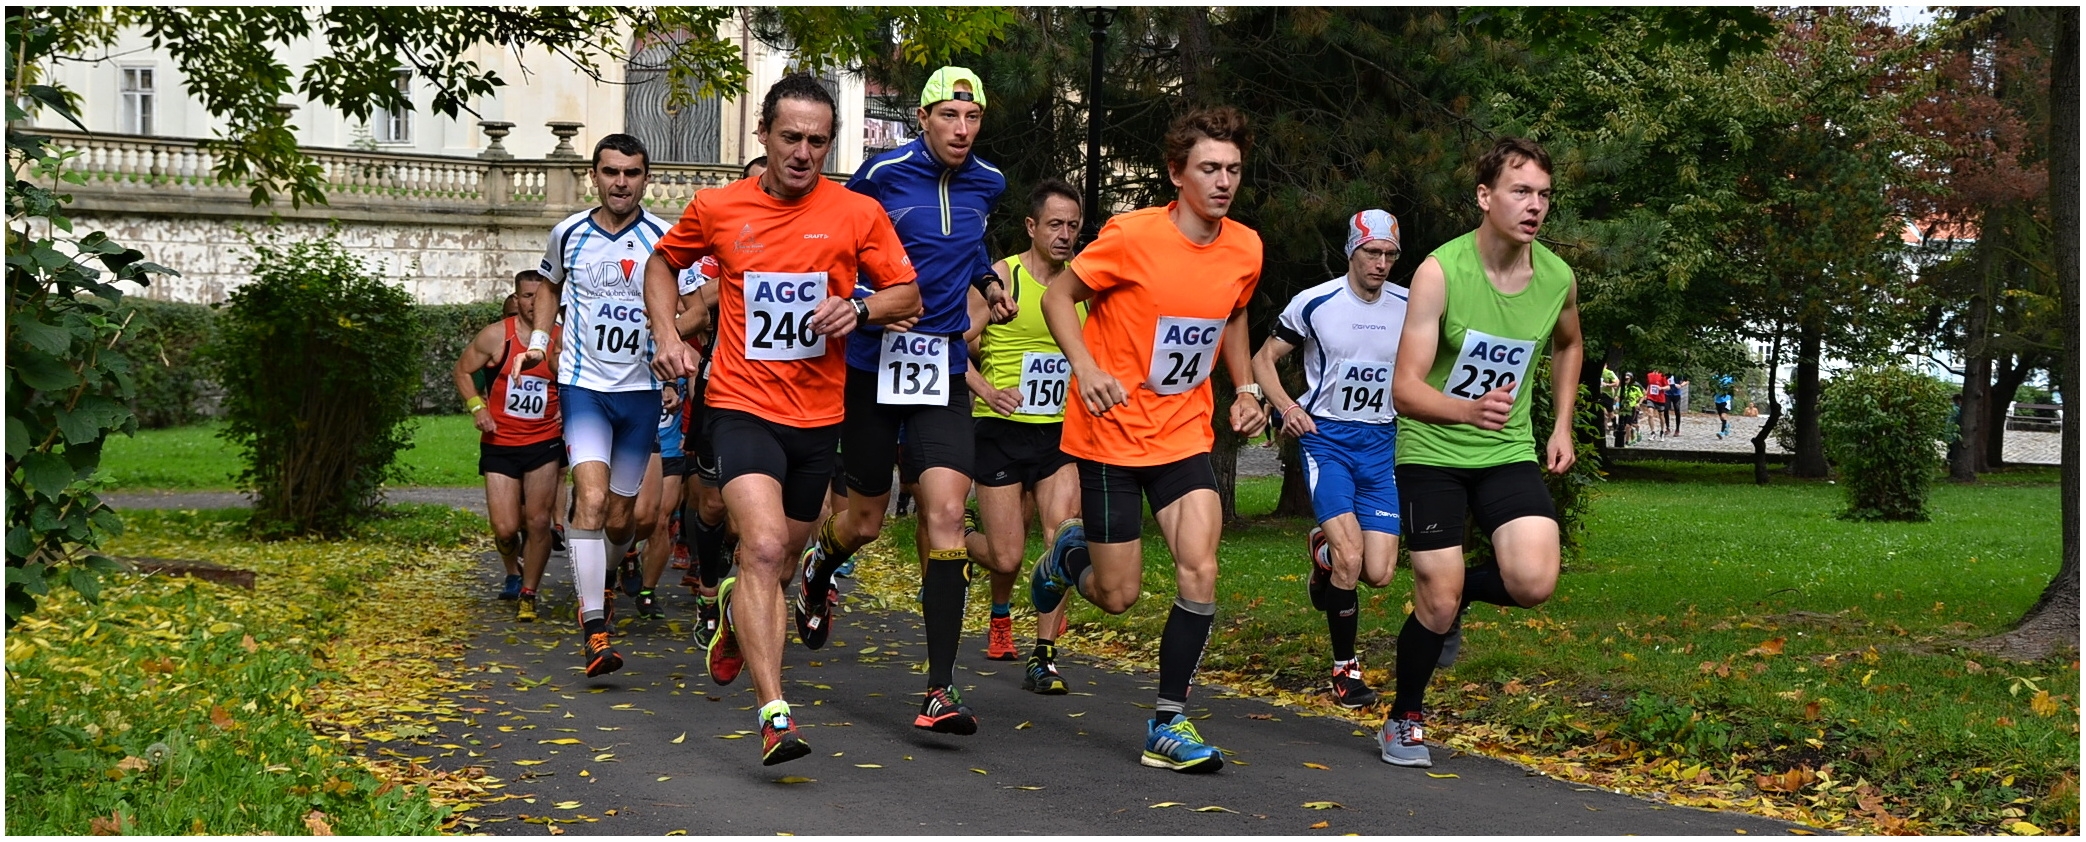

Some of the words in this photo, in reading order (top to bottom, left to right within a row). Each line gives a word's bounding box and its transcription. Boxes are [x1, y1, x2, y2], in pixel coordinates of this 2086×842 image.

[586, 258, 638, 289] VDV
[754, 281, 816, 303] AGC
[597, 303, 643, 323] AGC
[594, 324, 640, 356] 104
[752, 310, 819, 349] 246
[1163, 324, 1218, 346] AGC
[890, 334, 942, 357] AGC
[1468, 341, 1525, 365] AGC
[888, 361, 941, 396] 132
[1028, 358, 1068, 375] AGC
[1161, 352, 1202, 386] 24
[1344, 366, 1388, 383] AGC
[508, 394, 544, 414] 240
[1027, 379, 1066, 406] 150
[1341, 386, 1385, 413] 194
